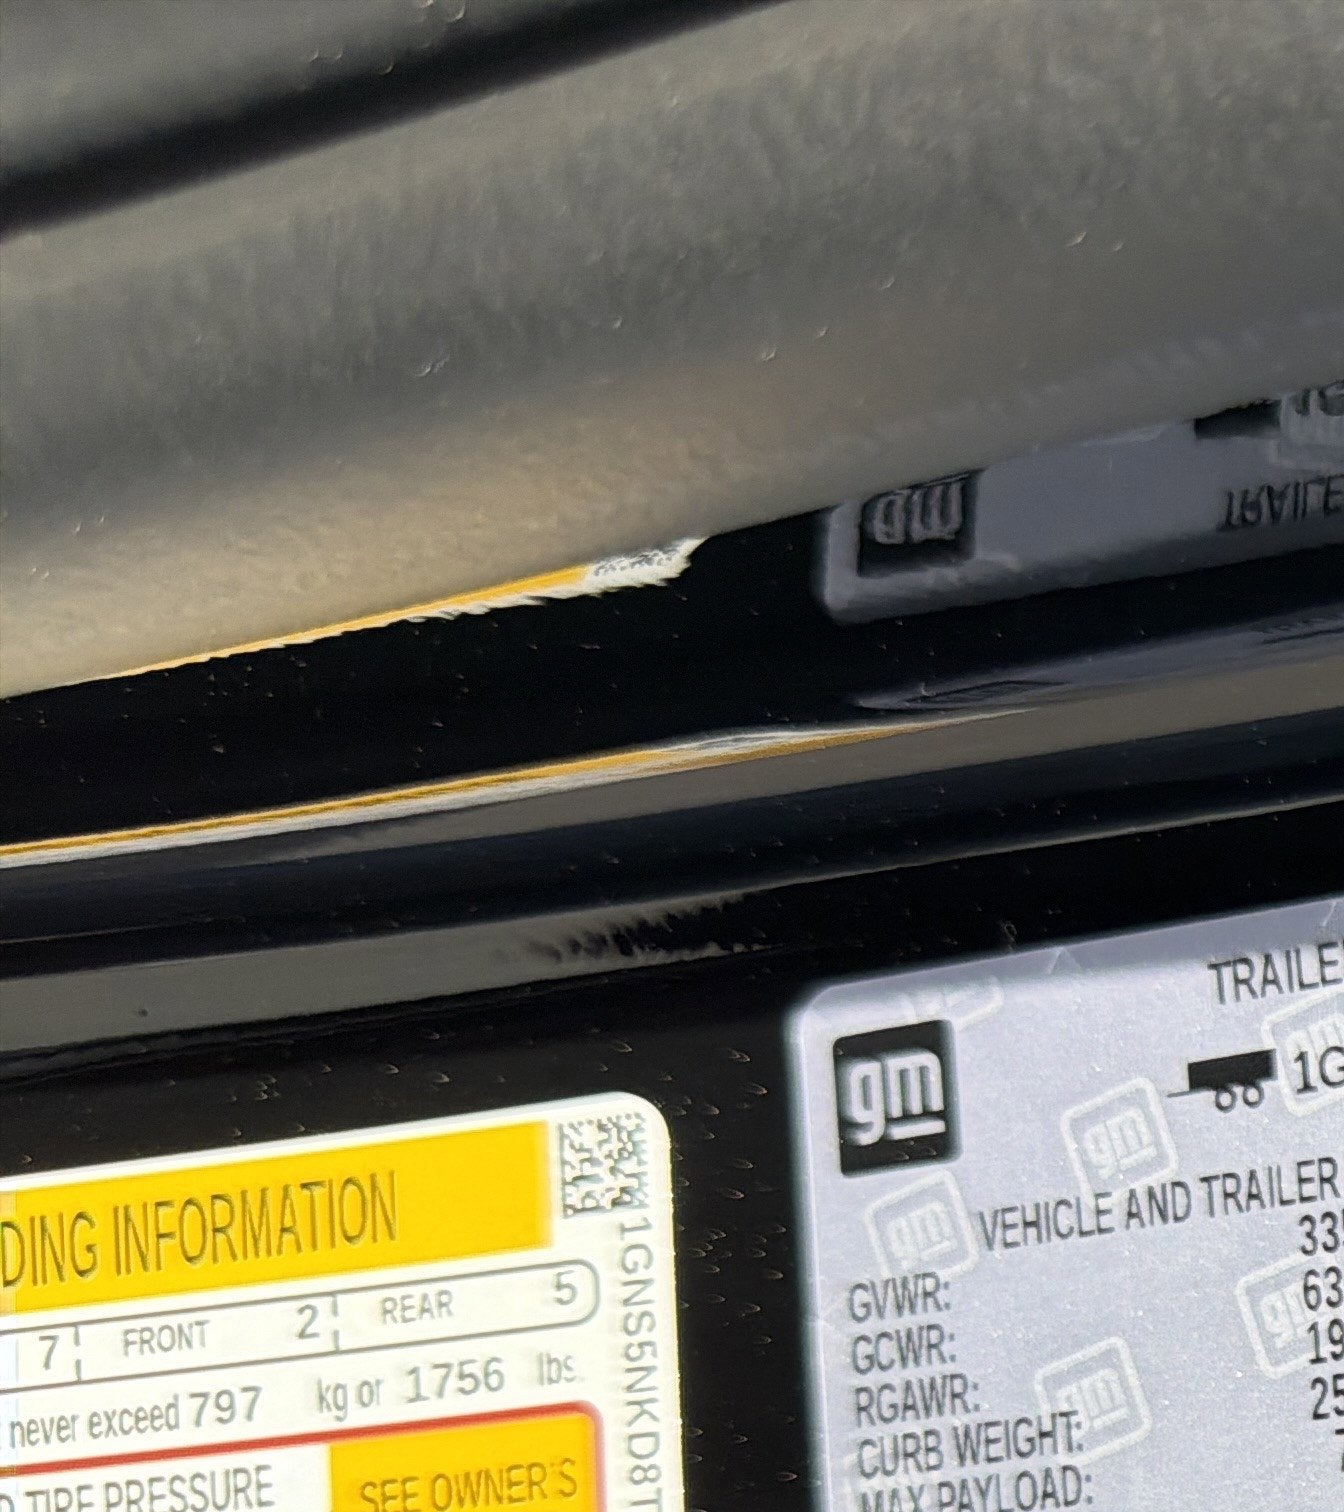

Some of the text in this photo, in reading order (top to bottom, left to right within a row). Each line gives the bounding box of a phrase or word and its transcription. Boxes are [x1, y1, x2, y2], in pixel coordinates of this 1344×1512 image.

[848, 1048, 947, 1145] gm
[0, 1170, 395, 1287] DING INFORMATION
[977, 1192, 1114, 1250] VEHICLE
[1126, 1181, 1191, 1229] AND
[1199, 1157, 1340, 1217] TRAILER
[39, 1270, 577, 1370] 7 FRONT 2 REAR 5
[847, 1272, 950, 1323] GVWR:
[851, 1324, 956, 1375] GCWR:
[10, 1415, 78, 1448] never
[88, 1394, 179, 1439] exceed
[189, 1386, 261, 1427] 797
[317, 1380, 347, 1421] kg
[357, 1379, 382, 1407] or
[406, 1357, 504, 1403] 1756
[854, 1373, 980, 1427] RGAWR:
[857, 1429, 943, 1479] CURB
[953, 1411, 1083, 1467] WEIGHT:
[430, 1458, 577, 1512] OWNER'S
